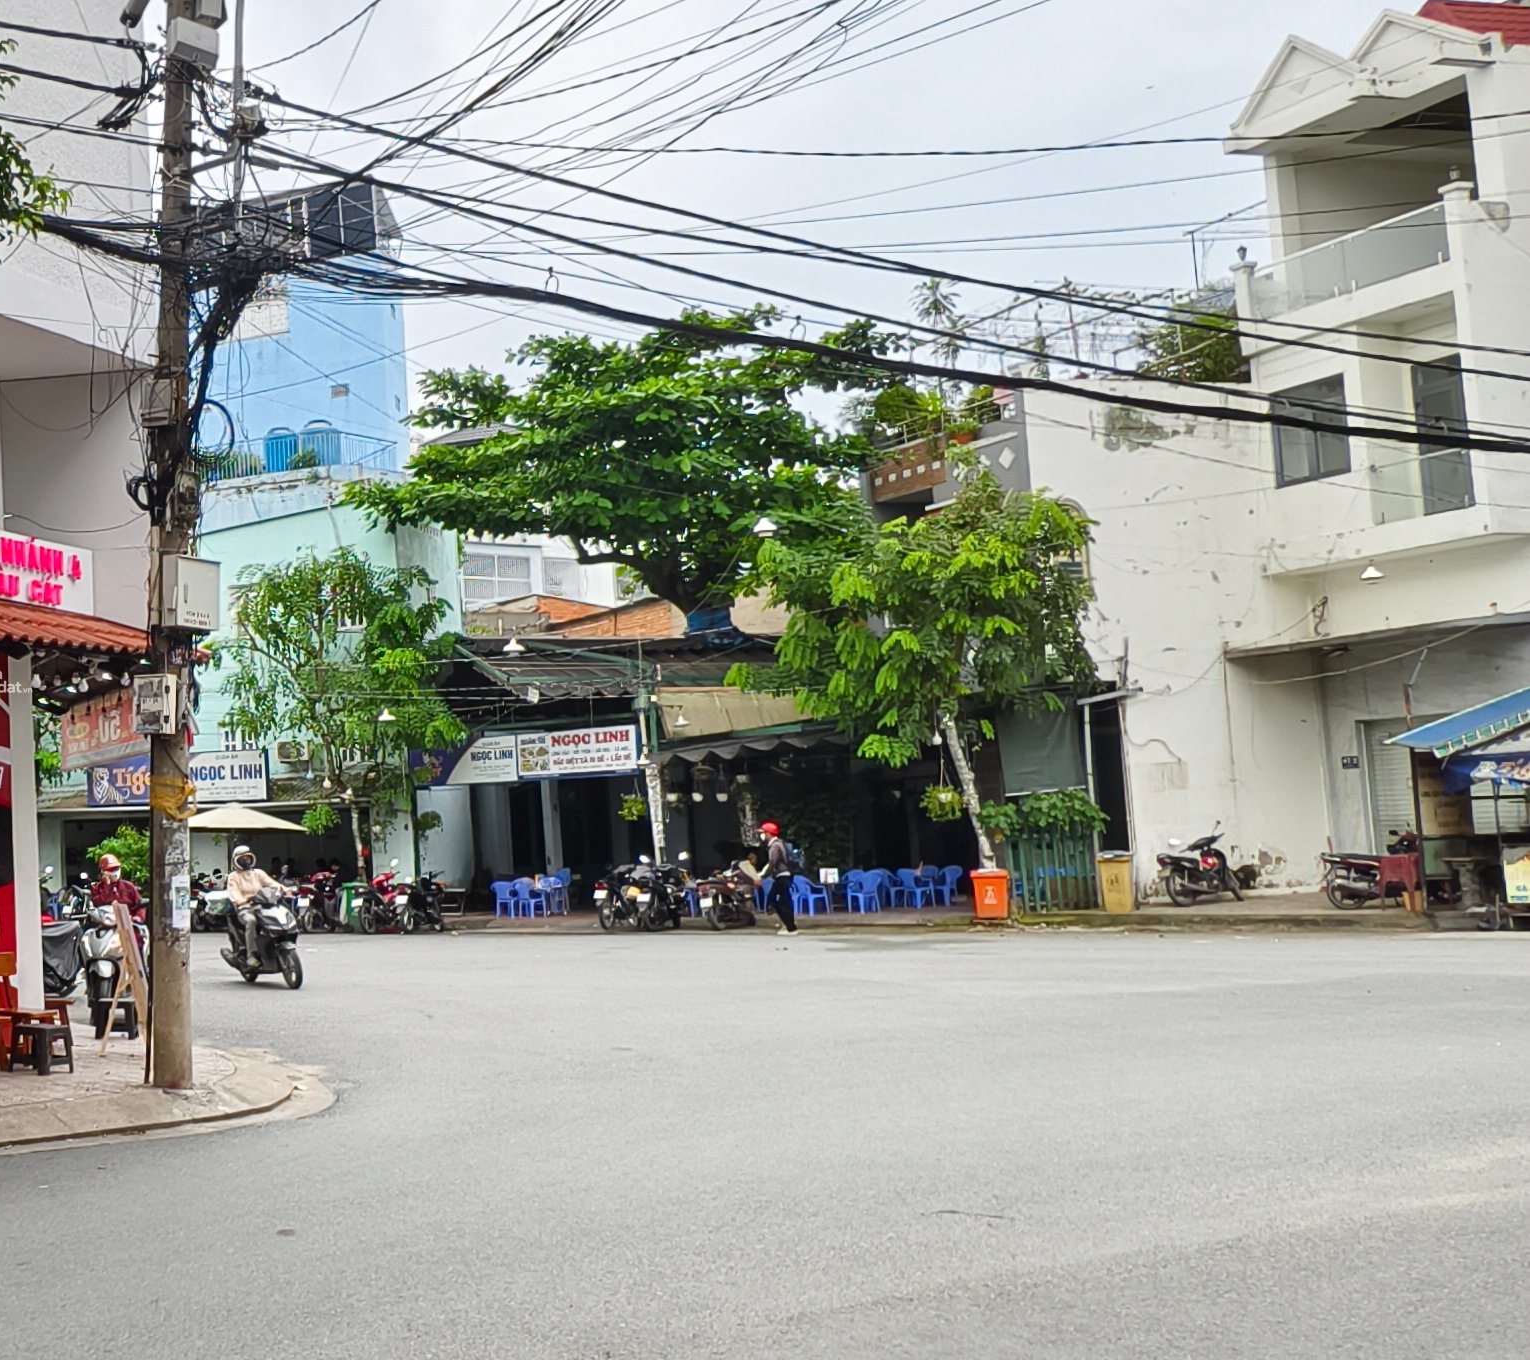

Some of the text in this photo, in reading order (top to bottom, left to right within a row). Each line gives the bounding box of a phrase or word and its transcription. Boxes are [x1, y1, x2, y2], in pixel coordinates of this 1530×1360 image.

[28, 574, 63, 605] CÁT
[551, 733, 590, 748] NGỌC
[594, 730, 629, 744] LINH
[471, 749, 513, 764] NGỌC LINH
[190, 763, 263, 787] NGỌC LINH
